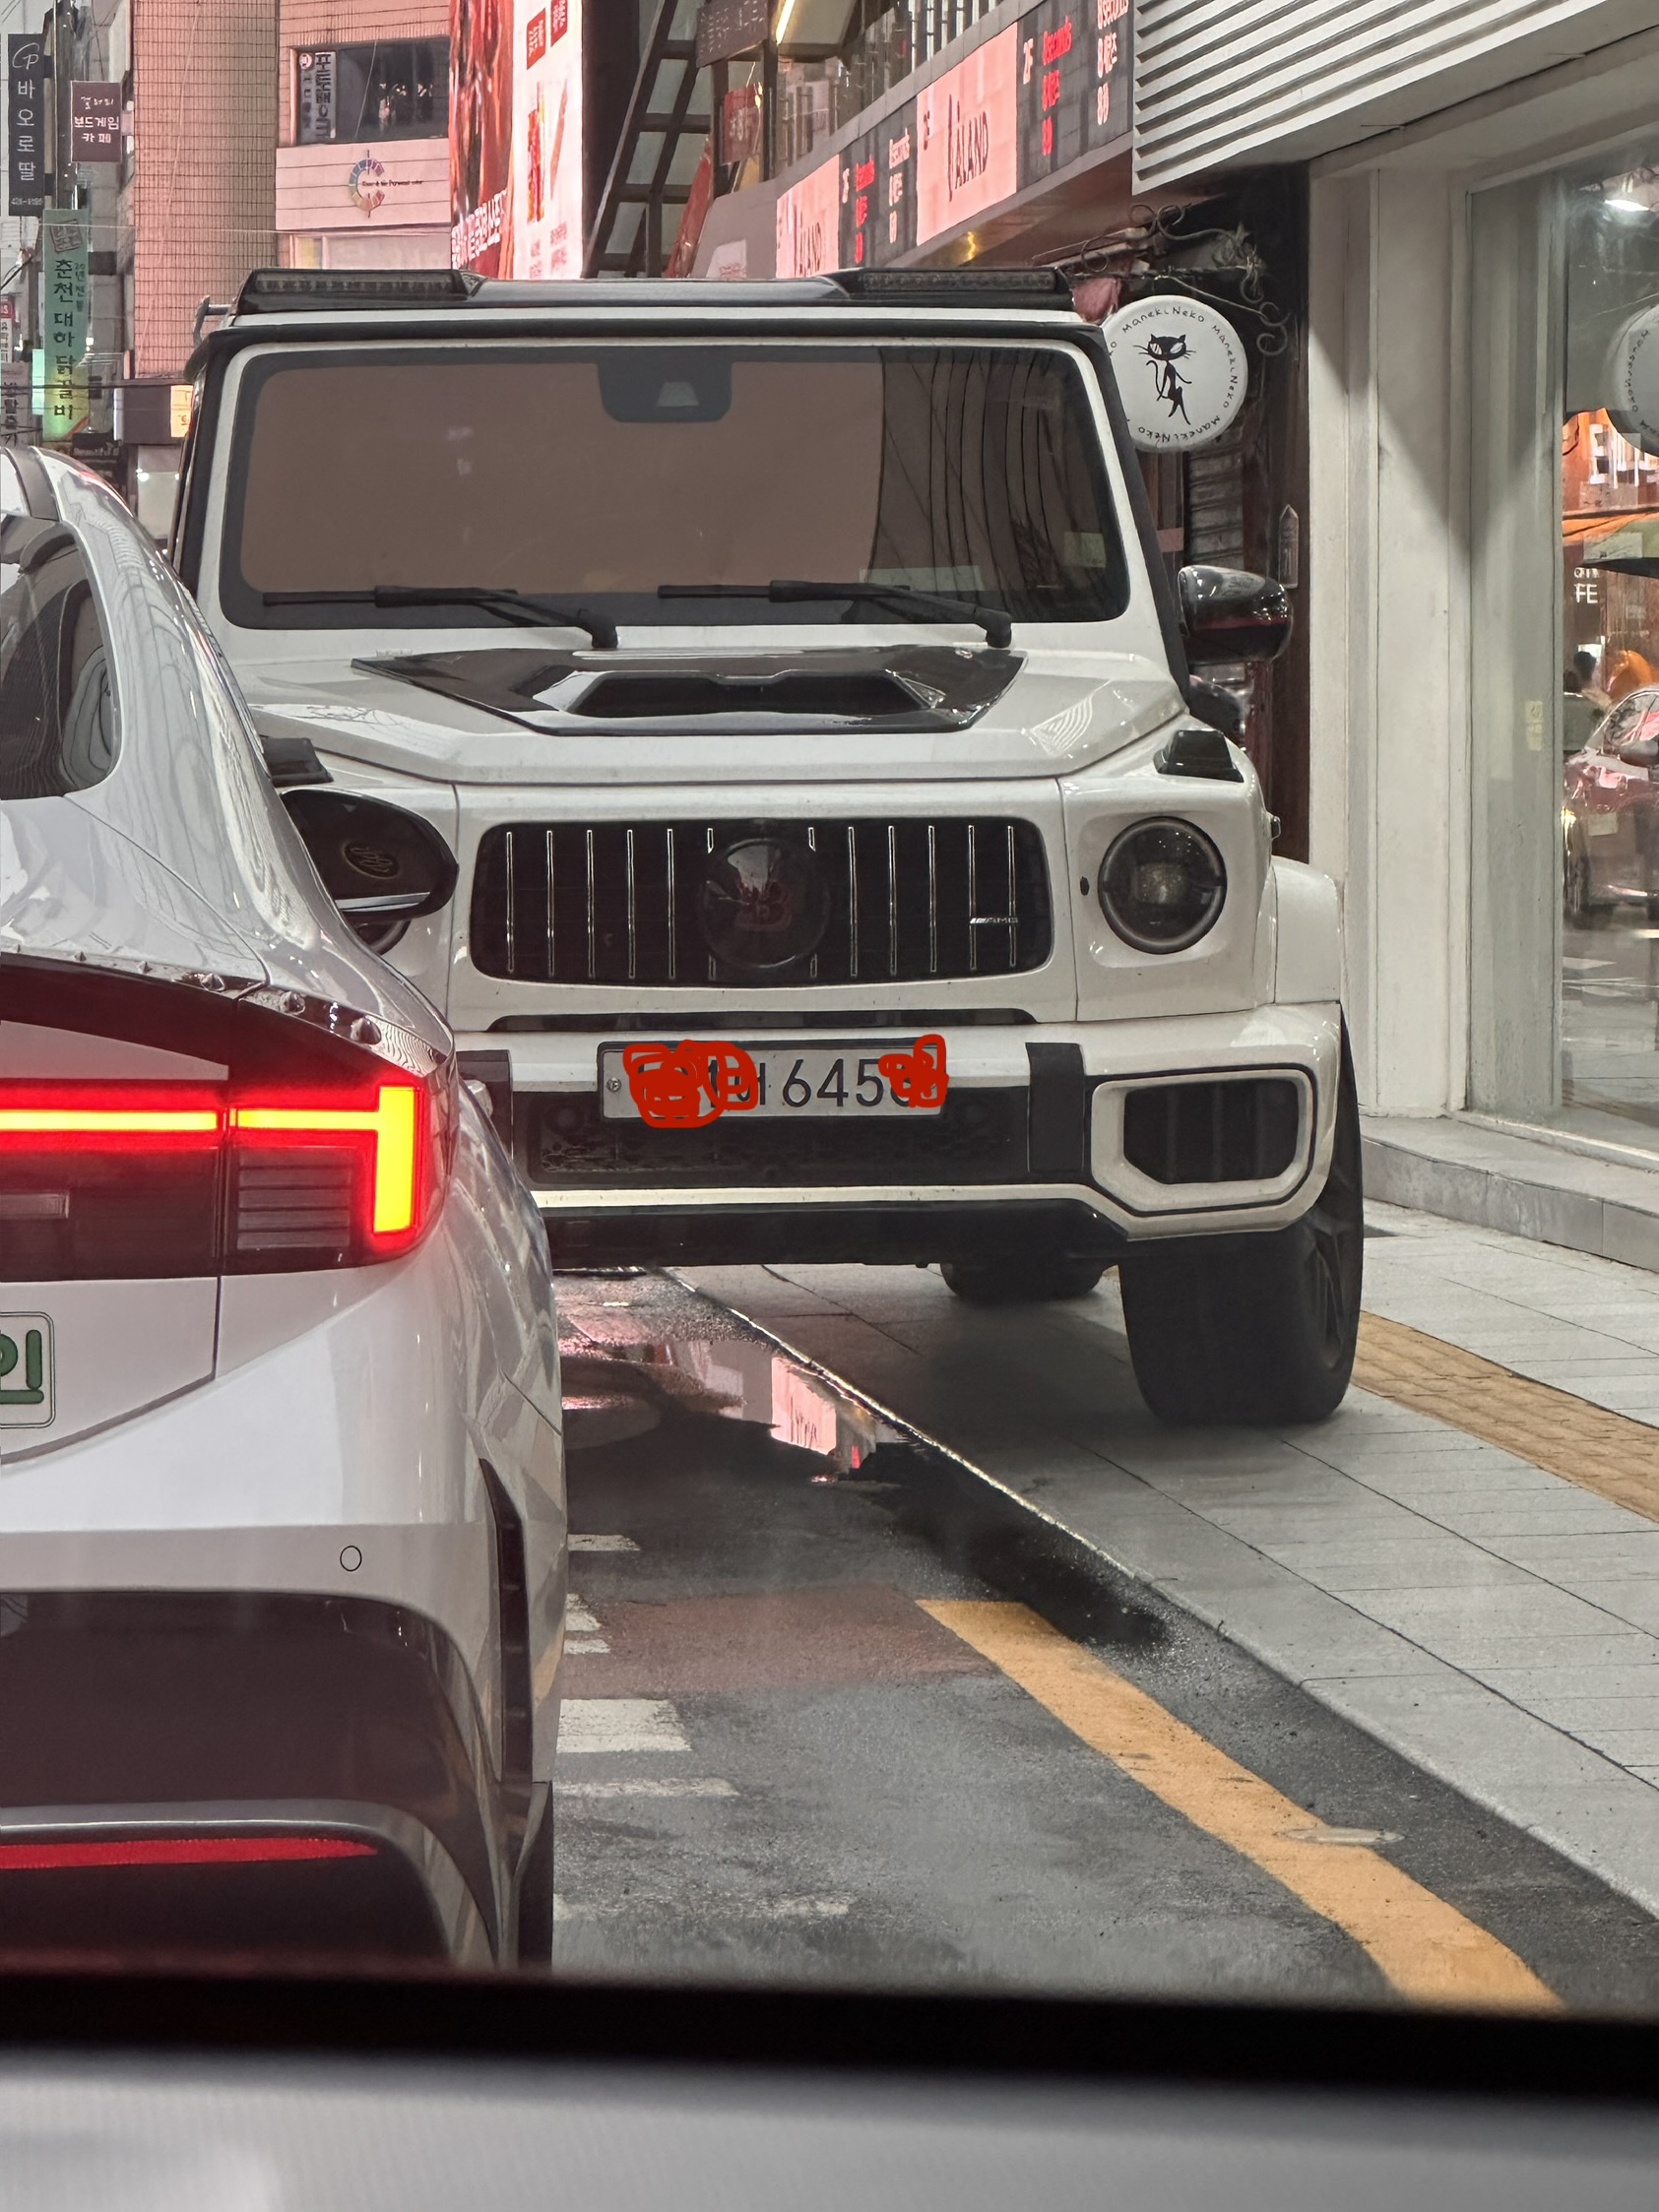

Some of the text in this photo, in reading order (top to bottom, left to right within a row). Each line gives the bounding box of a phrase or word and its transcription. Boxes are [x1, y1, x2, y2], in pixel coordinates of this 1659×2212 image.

[17, 79, 36, 181] 바오로딸
[74, 116, 119, 130] 보드게임
[783, 1058, 933, 1107] 645
